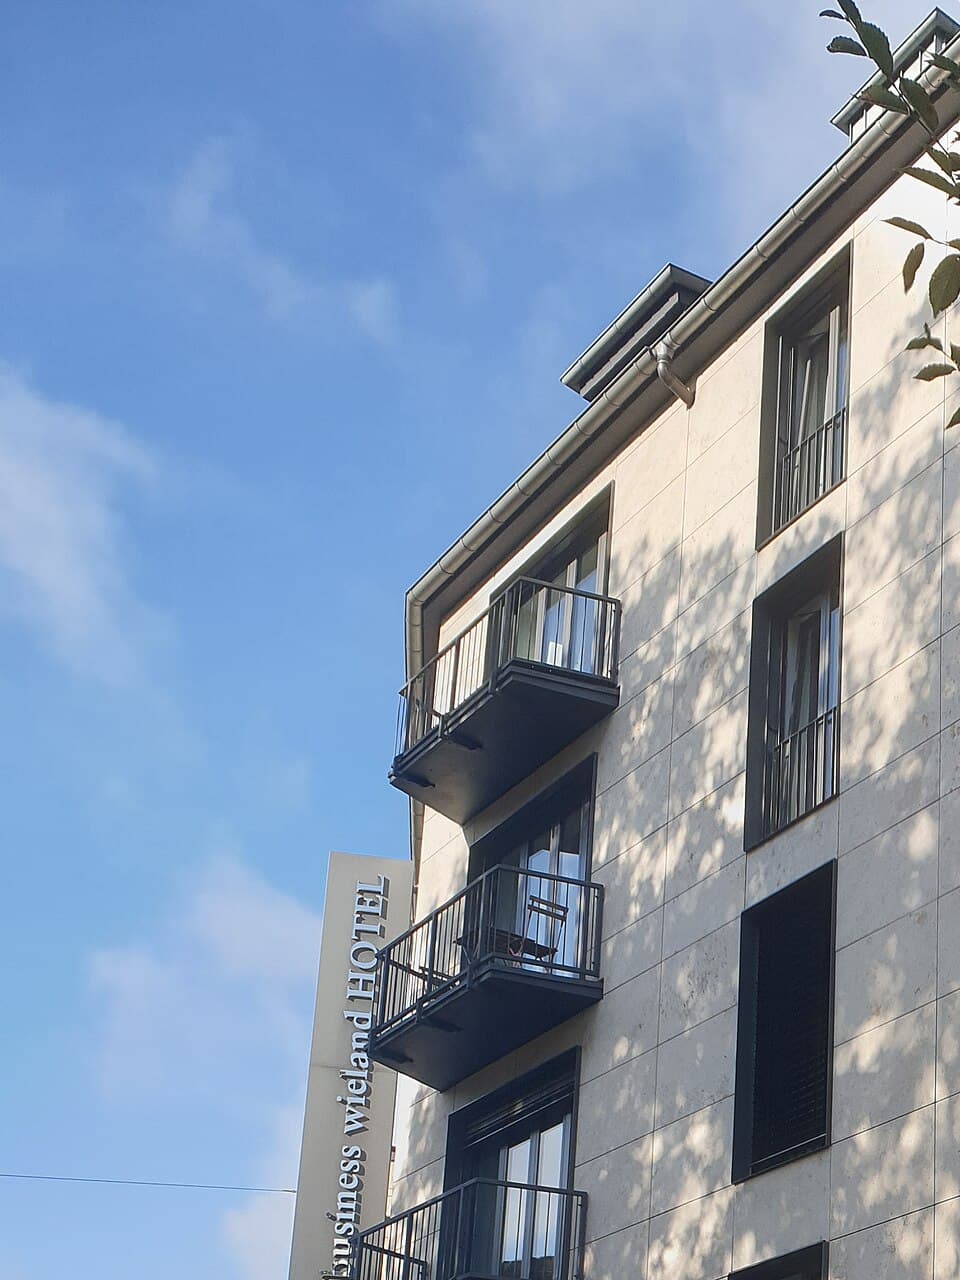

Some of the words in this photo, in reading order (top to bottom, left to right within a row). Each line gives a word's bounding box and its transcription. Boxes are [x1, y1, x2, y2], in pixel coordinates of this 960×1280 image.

[346, 873, 389, 1001] HOTEL
[336, 1010, 373, 1136] wieland
[322, 1145, 361, 1280] business
